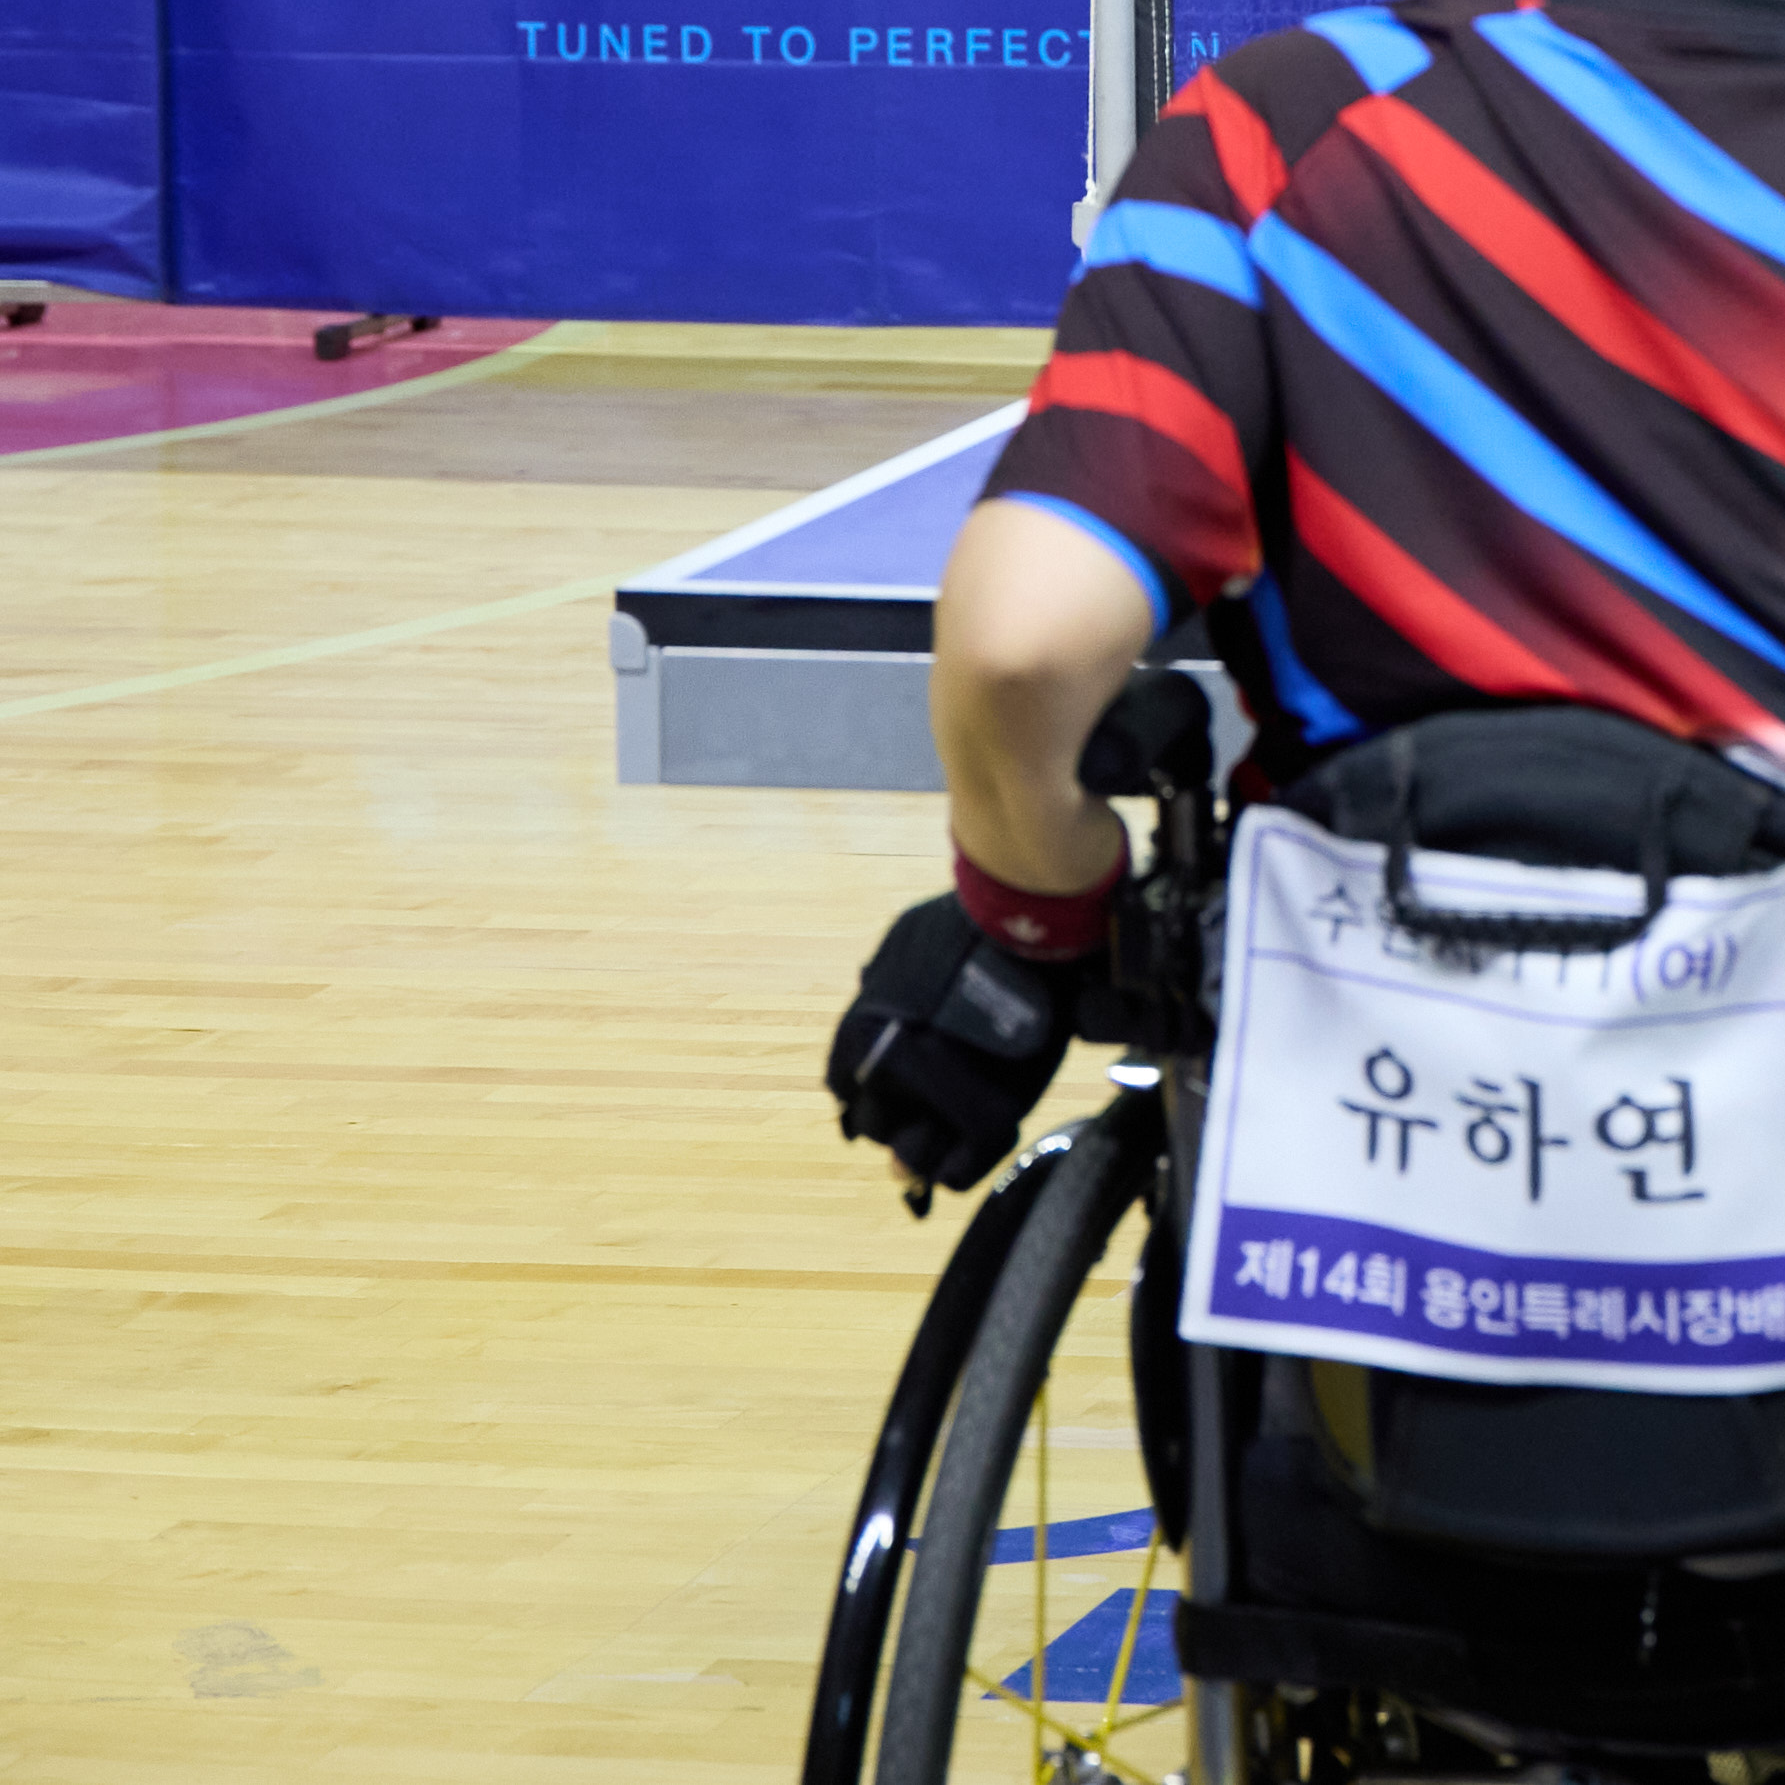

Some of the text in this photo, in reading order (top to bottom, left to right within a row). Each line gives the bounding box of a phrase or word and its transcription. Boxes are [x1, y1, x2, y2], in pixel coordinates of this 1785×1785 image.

[516, 21, 713, 64] TUNED
[742, 26, 816, 65] TO
[1338, 1046, 1708, 1205] 유하연
[1234, 1237, 1408, 1317] 제14회
